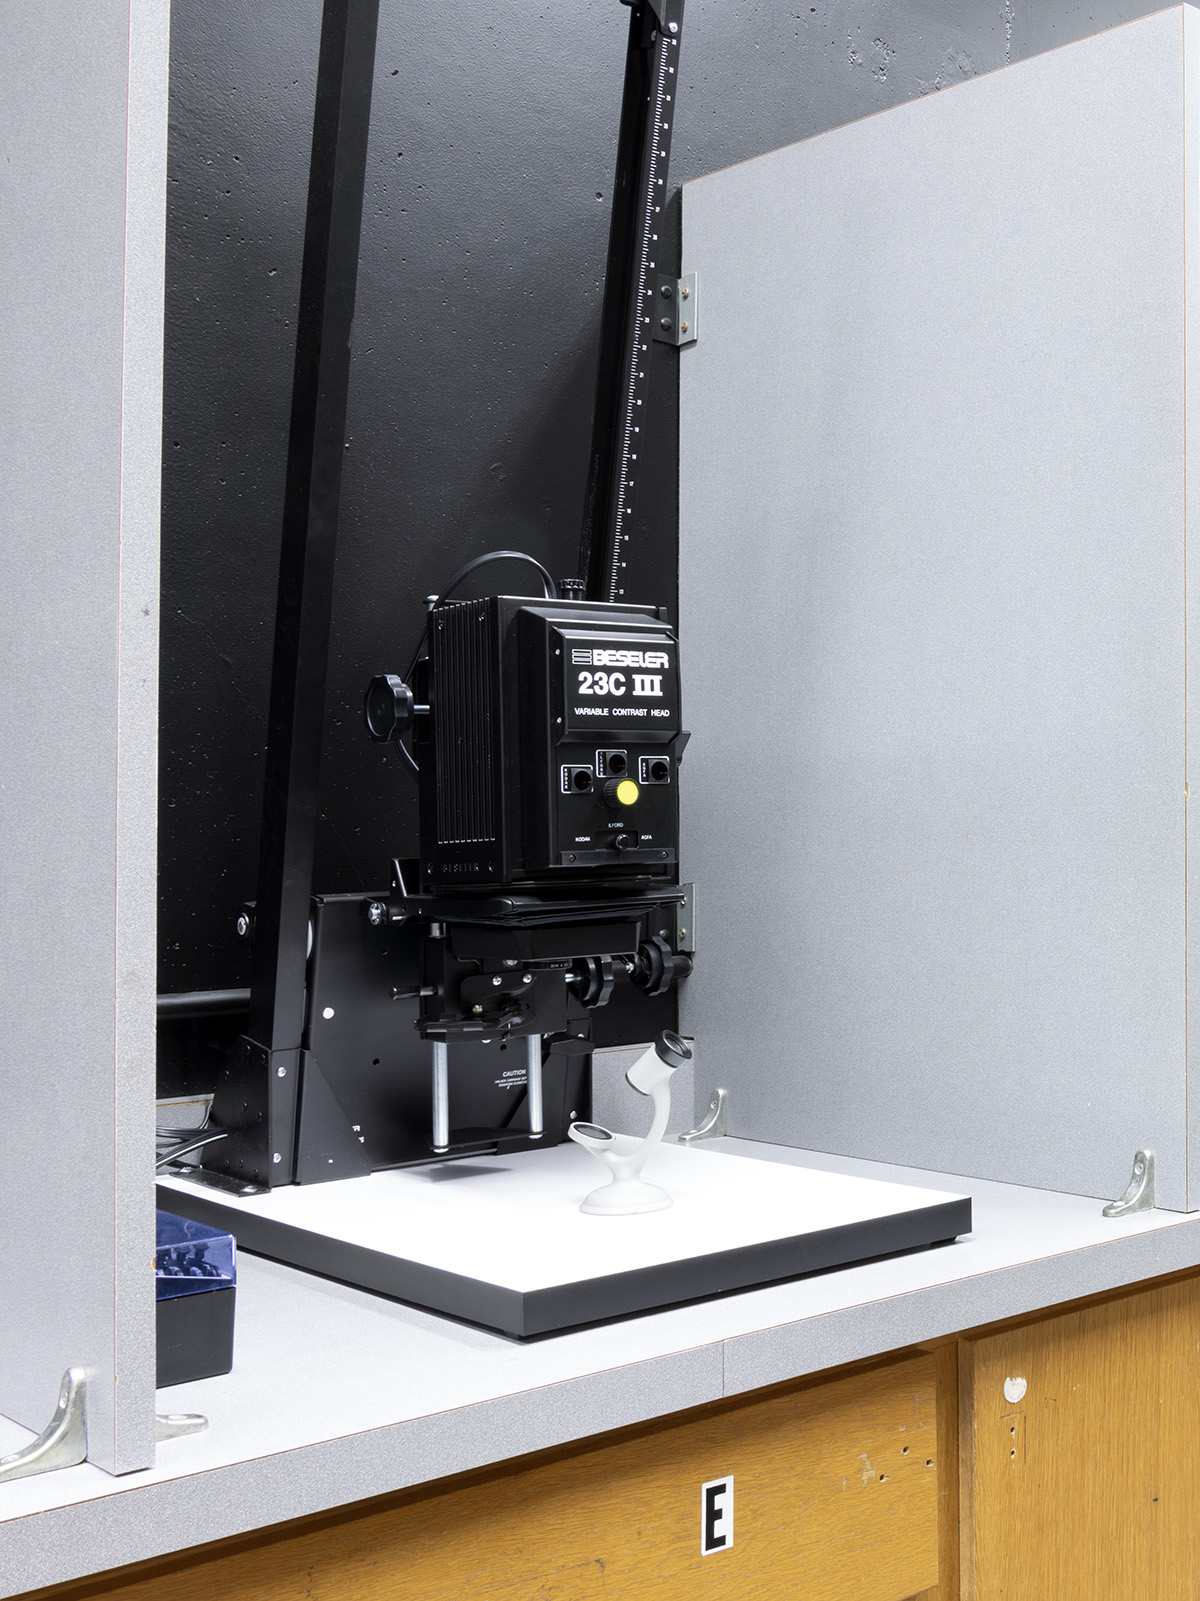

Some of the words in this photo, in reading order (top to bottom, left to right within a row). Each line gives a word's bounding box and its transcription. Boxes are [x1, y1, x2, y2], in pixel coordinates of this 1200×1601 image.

[593, 649, 669, 669] BESELER
[578, 671, 626, 696] 23C
[632, 674, 663, 696] III
[574, 707, 609, 716] VARIABLE
[612, 708, 648, 717] CONTRAST
[651, 709, 670, 717] HEAD
[502, 1069, 527, 1077] CAUTION
[705, 1483, 727, 1551] E
